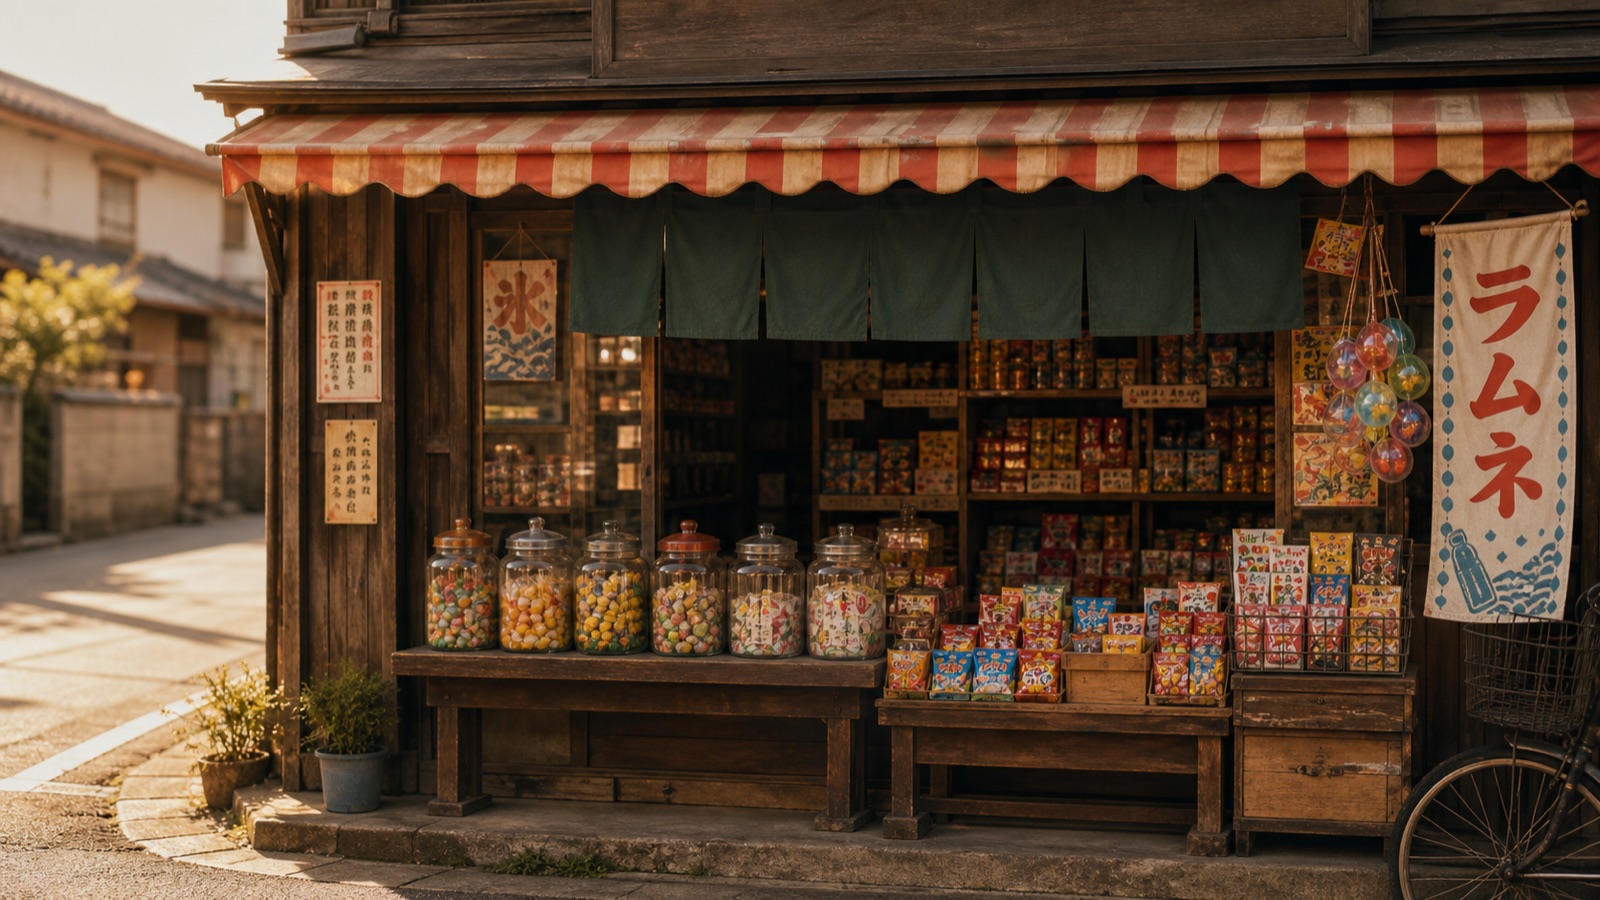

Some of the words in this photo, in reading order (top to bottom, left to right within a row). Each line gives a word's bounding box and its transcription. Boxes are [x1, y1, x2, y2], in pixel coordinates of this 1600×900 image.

[493, 270, 547, 335] 氷
[1469, 264, 1543, 519] ラムネ
